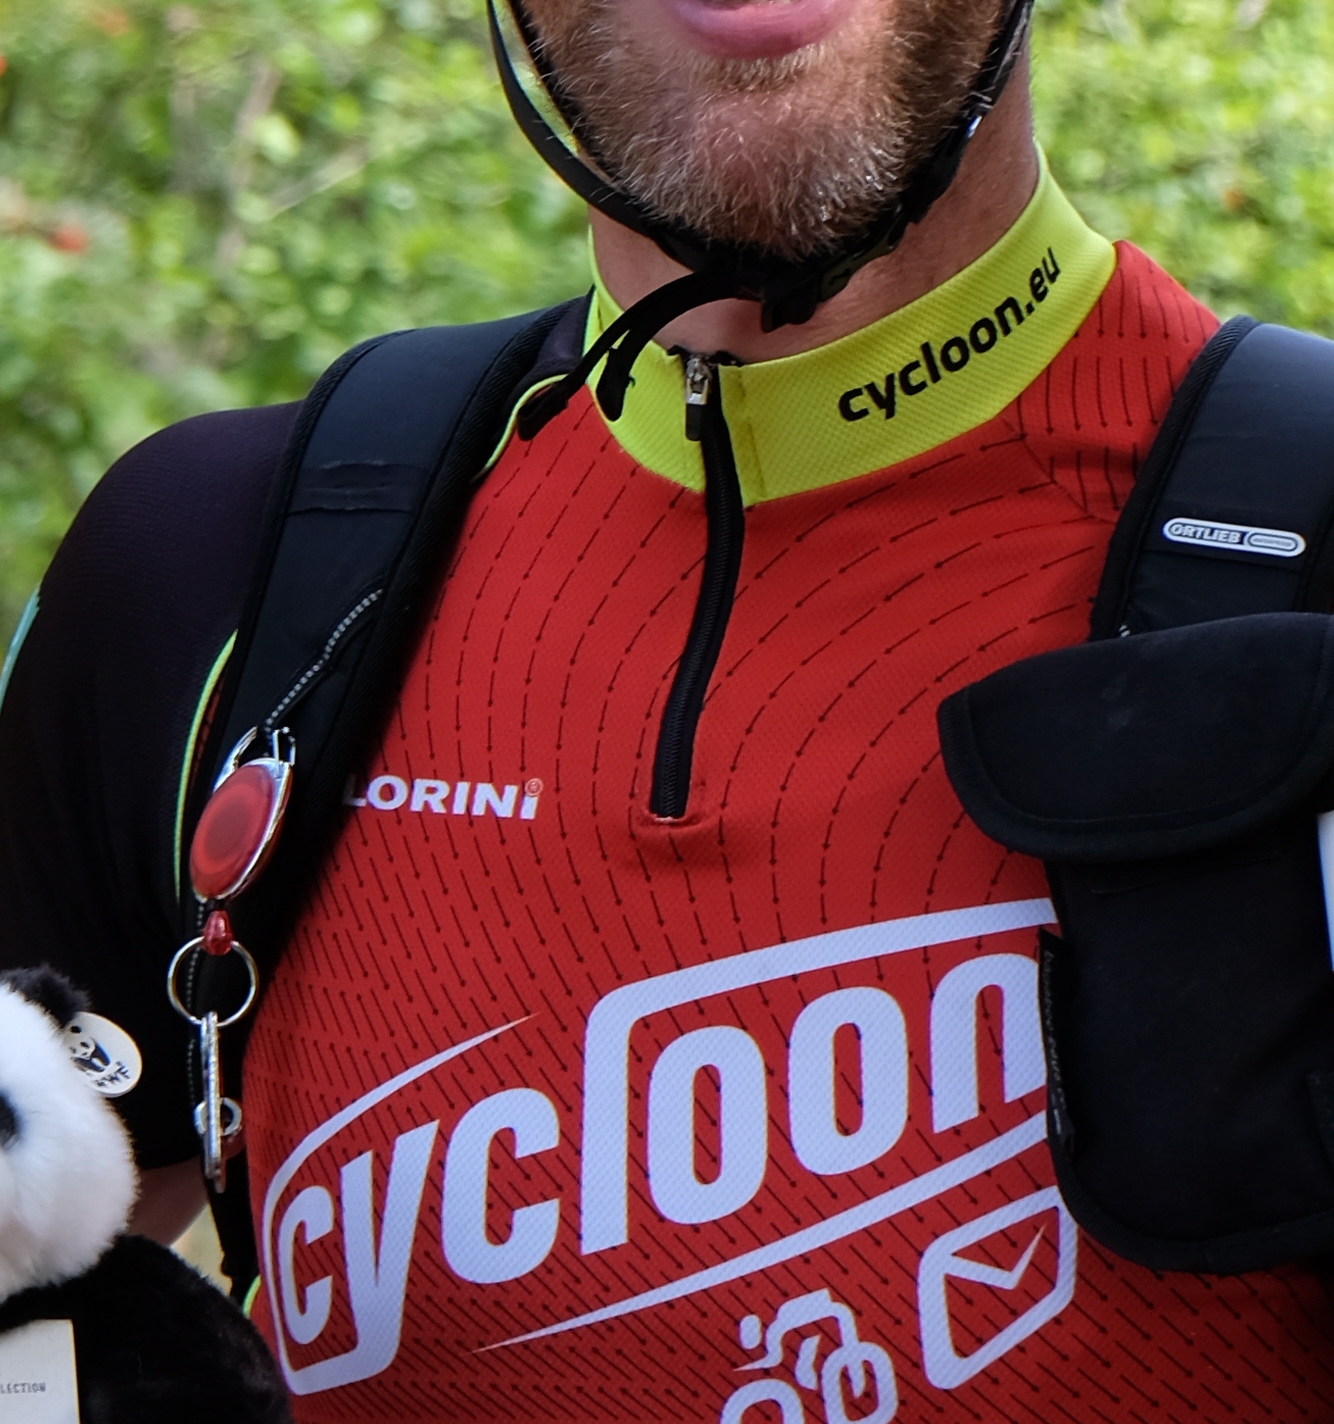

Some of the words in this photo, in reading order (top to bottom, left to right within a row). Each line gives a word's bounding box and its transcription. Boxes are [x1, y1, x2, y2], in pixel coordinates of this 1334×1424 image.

[837, 247, 1062, 422] cycloon.eu
[1170, 523, 1241, 543] ORTLIEB
[265, 898, 1058, 1396] cycloon
